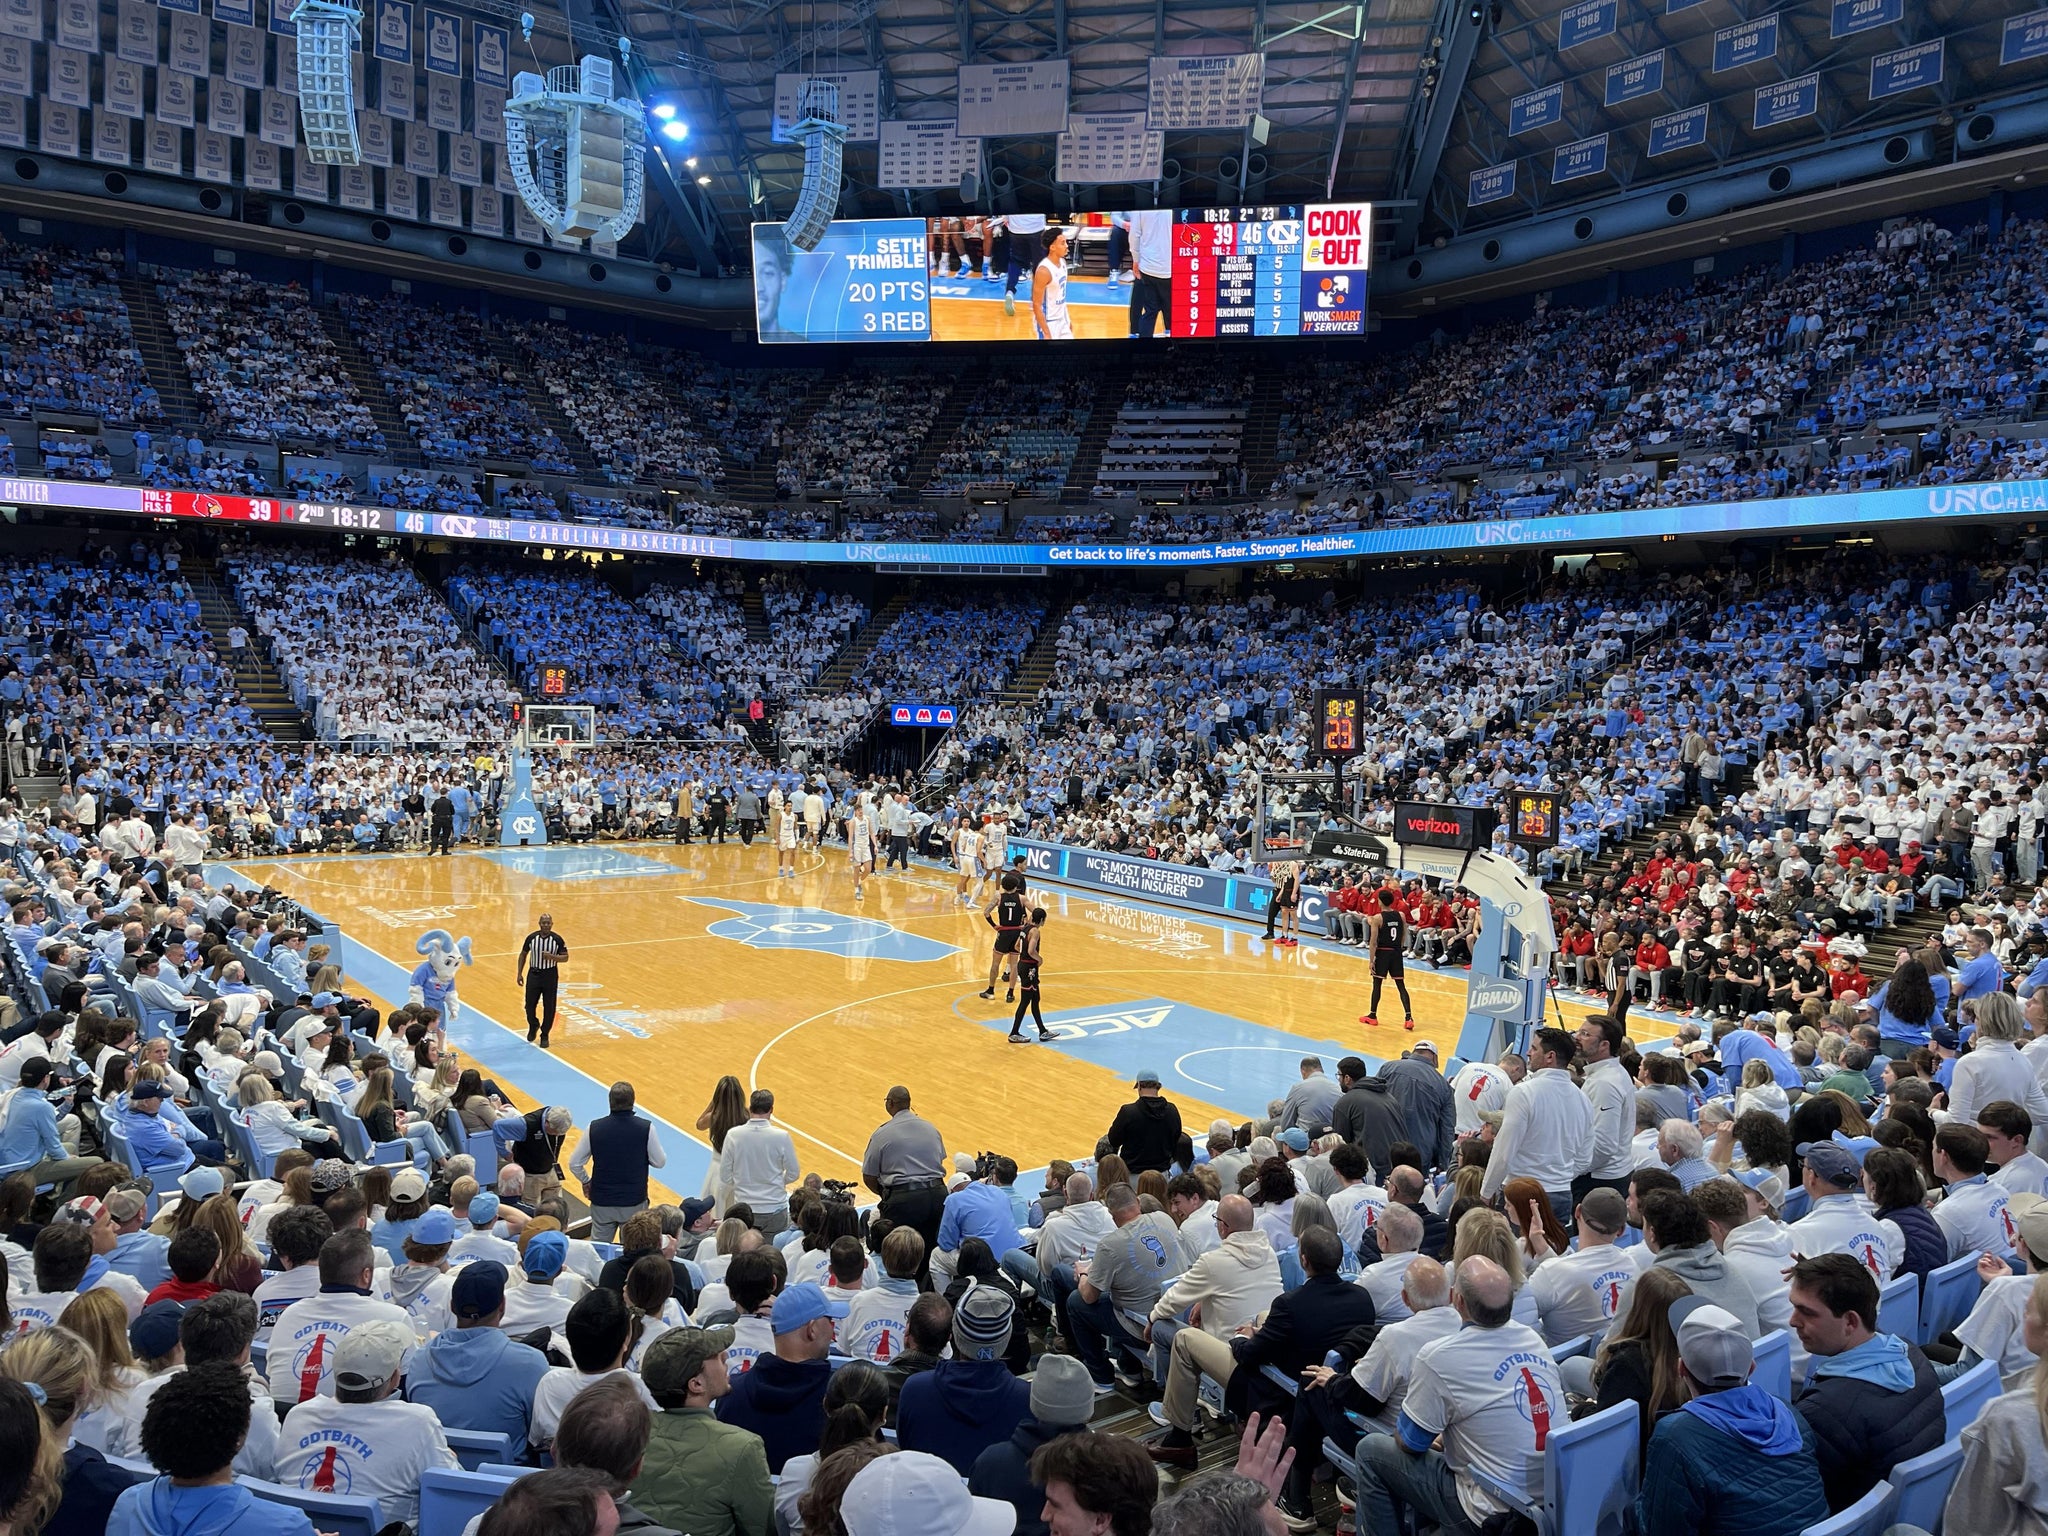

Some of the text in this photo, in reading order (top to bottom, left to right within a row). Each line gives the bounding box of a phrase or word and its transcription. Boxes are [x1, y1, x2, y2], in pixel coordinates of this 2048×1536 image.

[388, 22, 399, 33] 23
[1577, 11, 1600, 29] 1988
[1717, 17, 1776, 42] ACC CHAMPIONS
[438, 35, 449, 46] 33
[1732, 36, 1759, 52] 1998
[486, 49, 497, 60] 50
[1875, 42, 1941, 68] ACC CHAMPIONS
[1609, 53, 1662, 77] ACC CHAMPIONS
[1892, 59, 1920, 78] 2017
[1623, 69, 1646, 85] 1997
[1758, 76, 1817, 100] ACC CHAMPIONS
[1513, 87, 1561, 109] ACC CHAMPIONS
[1772, 91, 1800, 109] 2016
[1525, 102, 1547, 117] 1995
[1653, 107, 1706, 129] ACC CHAMPIONS
[1665, 122, 1690, 139] 2012
[1569, 137, 1606, 154] CHAMPIONS
[1568, 152, 1592, 166] 2011
[1481, 176, 1503, 191] 2009
[1204, 209, 1230, 222] 18:12
[1261, 207, 1274, 220] 23
[1308, 210, 1361, 236] COOK
[1213, 223, 1234, 245] 39
[1242, 222, 1262, 244] 46
[877, 238, 925, 254] SETH
[1277, 245, 1290, 253] FLS:
[1324, 240, 1361, 264] OUT
[846, 254, 925, 270] TRIMBLE
[1191, 258, 1199, 270] 6
[1274, 256, 1282, 269] 5
[1191, 275, 1199, 287] 5
[1274, 273, 1282, 285] 5
[849, 283, 876, 302] 20
[881, 282, 926, 302] PTS
[1190, 291, 1198, 303] 5
[1274, 289, 1282, 301] 5
[1190, 307, 1198, 319] 8
[1273, 306, 1281, 318] 5
[1304, 311, 1361, 321] WORKSMART
[864, 312, 926, 332] 3 REB
[1190, 323, 1198, 335] 7
[1221, 324, 1248, 333] ASSISTS
[1273, 321, 1281, 334] 7
[1303, 322, 1359, 331] IT SERVICES
[5, 482, 49, 502] CENTER
[144, 490, 172, 502] TOL: 2
[1929, 485, 2005, 514] UNC
[144, 501, 172, 513] FLS: 0
[249, 501, 271, 521] 39
[299, 504, 381, 528] 2ND 18:12
[404, 514, 424, 532] 46
[529, 526, 717, 554] CAROLINA BASKETBALL
[1475, 522, 1573, 544] UNC HEALTH
[846, 545, 887, 560] UNC
[1049, 537, 1356, 561] Get back to life's moments. Faster. Stronger. Healthier.
[546, 678, 563, 693] 23
[1328, 699, 1355, 717] 18:12
[1327, 719, 1352, 750] 23
[1520, 800, 1552, 814] 18:12
[1407, 817, 1460, 835] verizon
[1523, 815, 1545, 835] 23
[1027, 851, 1051, 870] NC
[1421, 863, 1457, 875] SPALDING
[1086, 857, 1204, 888] NC'S MOST PREFERRED
[1100, 871, 1188, 898] HEALTH INSURER
[1008, 907, 1013, 921] 1
[1390, 927, 1397, 941] 9
[1470, 989, 1518, 1010] LIBMAN
[10, 1308, 54, 1326] OTBATH
[864, 1319, 906, 1332] GOTBAT
[1494, 1352, 1547, 1381] GOTBATH
[300, 1429, 374, 1460] GOTBATH
